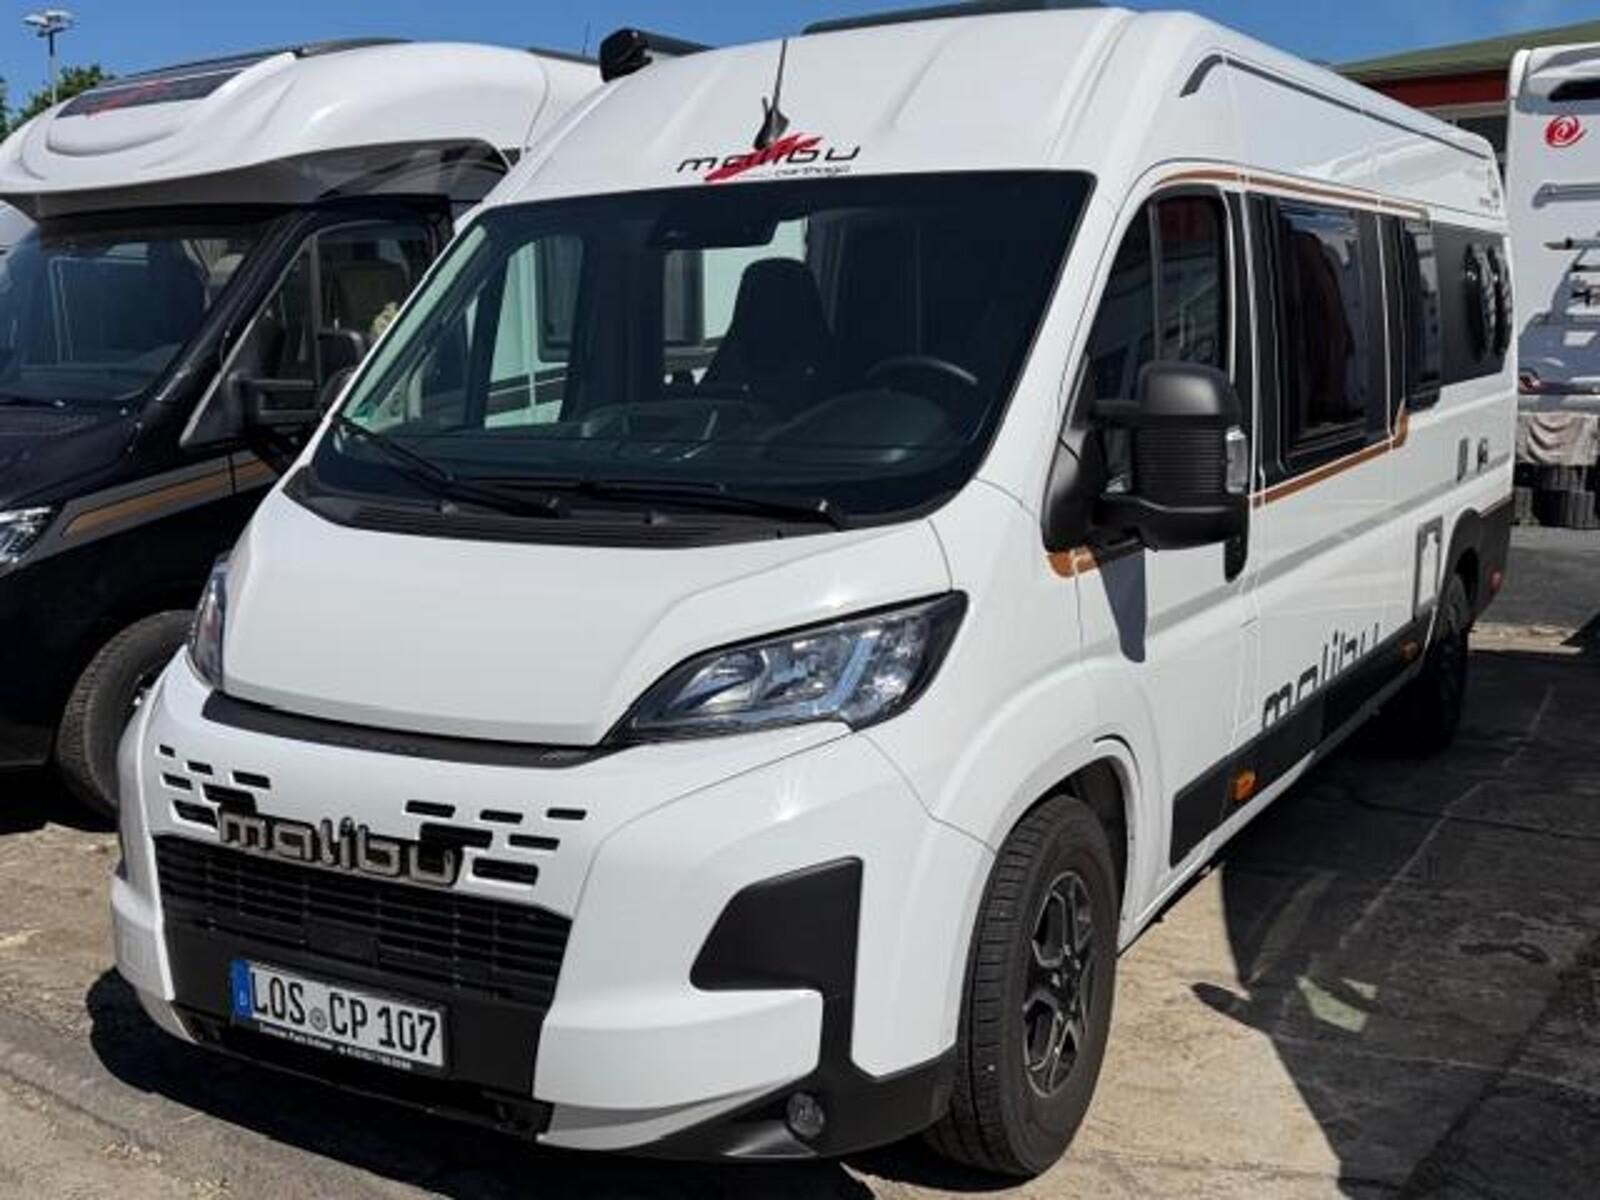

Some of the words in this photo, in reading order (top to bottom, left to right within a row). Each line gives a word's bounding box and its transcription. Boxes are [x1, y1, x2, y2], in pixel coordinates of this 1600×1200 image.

[218, 816, 456, 886] malibu
[251, 972, 306, 1025] LOS
[329, 992, 368, 1040] CP
[377, 1006, 436, 1056] 107
